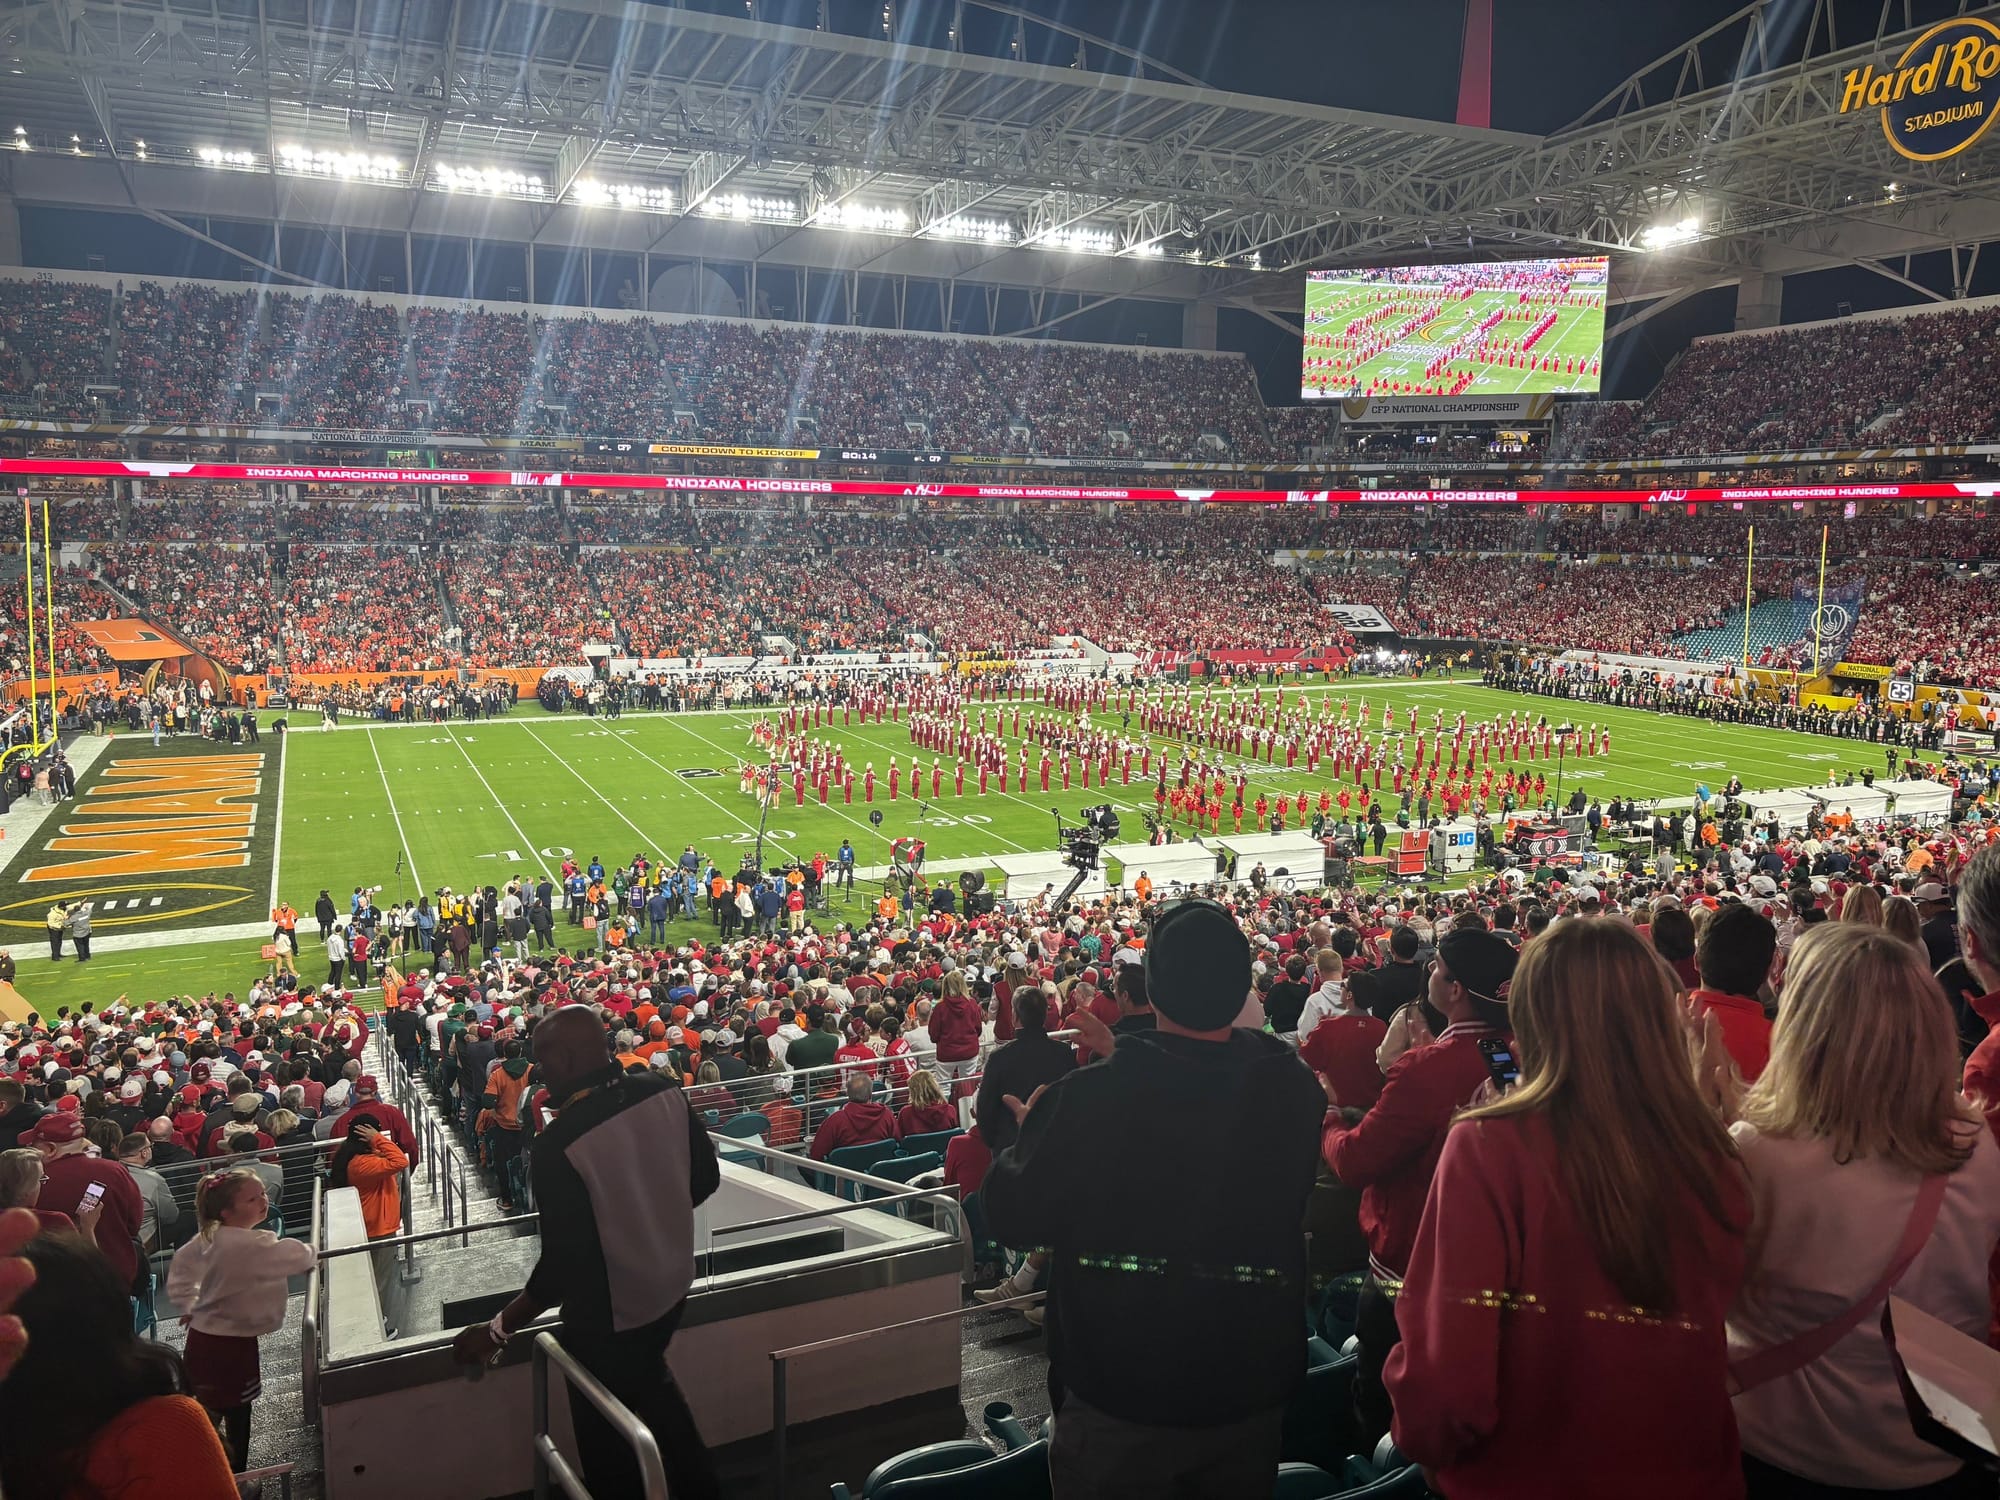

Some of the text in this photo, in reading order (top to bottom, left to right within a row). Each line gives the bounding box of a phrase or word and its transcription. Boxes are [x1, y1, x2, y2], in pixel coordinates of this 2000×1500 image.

[1839, 44, 1949, 114] Hard
[1904, 101, 1984, 133] STADIUM
[1371, 403, 1520, 414] CFP NATIONAL CHAMPIONSHIP
[311, 432, 427, 443] NATIONAL CHAMPIONSHIP
[519, 440, 556, 448] MIAMI
[661, 446, 736, 455] COUNTDOWN
[756, 449, 806, 457] KICKOFF
[842, 451, 877, 460] 20:14
[246, 468, 469, 481] INDIANA MARCHING HUNDRED
[666, 478, 832, 491] INDIANA HOOSIERS
[1359, 491, 1518, 501] INDIANA HOOSIERS
[1771, 489, 1835, 497] MARCHING
[1838, 487, 1899, 495] HUNDRED
[1847, 665, 1880, 673] NATIONAL
[1891, 683, 1910, 698] 25
[18, 753, 265, 882] MIAMI
[499, 846, 574, 862] 10
